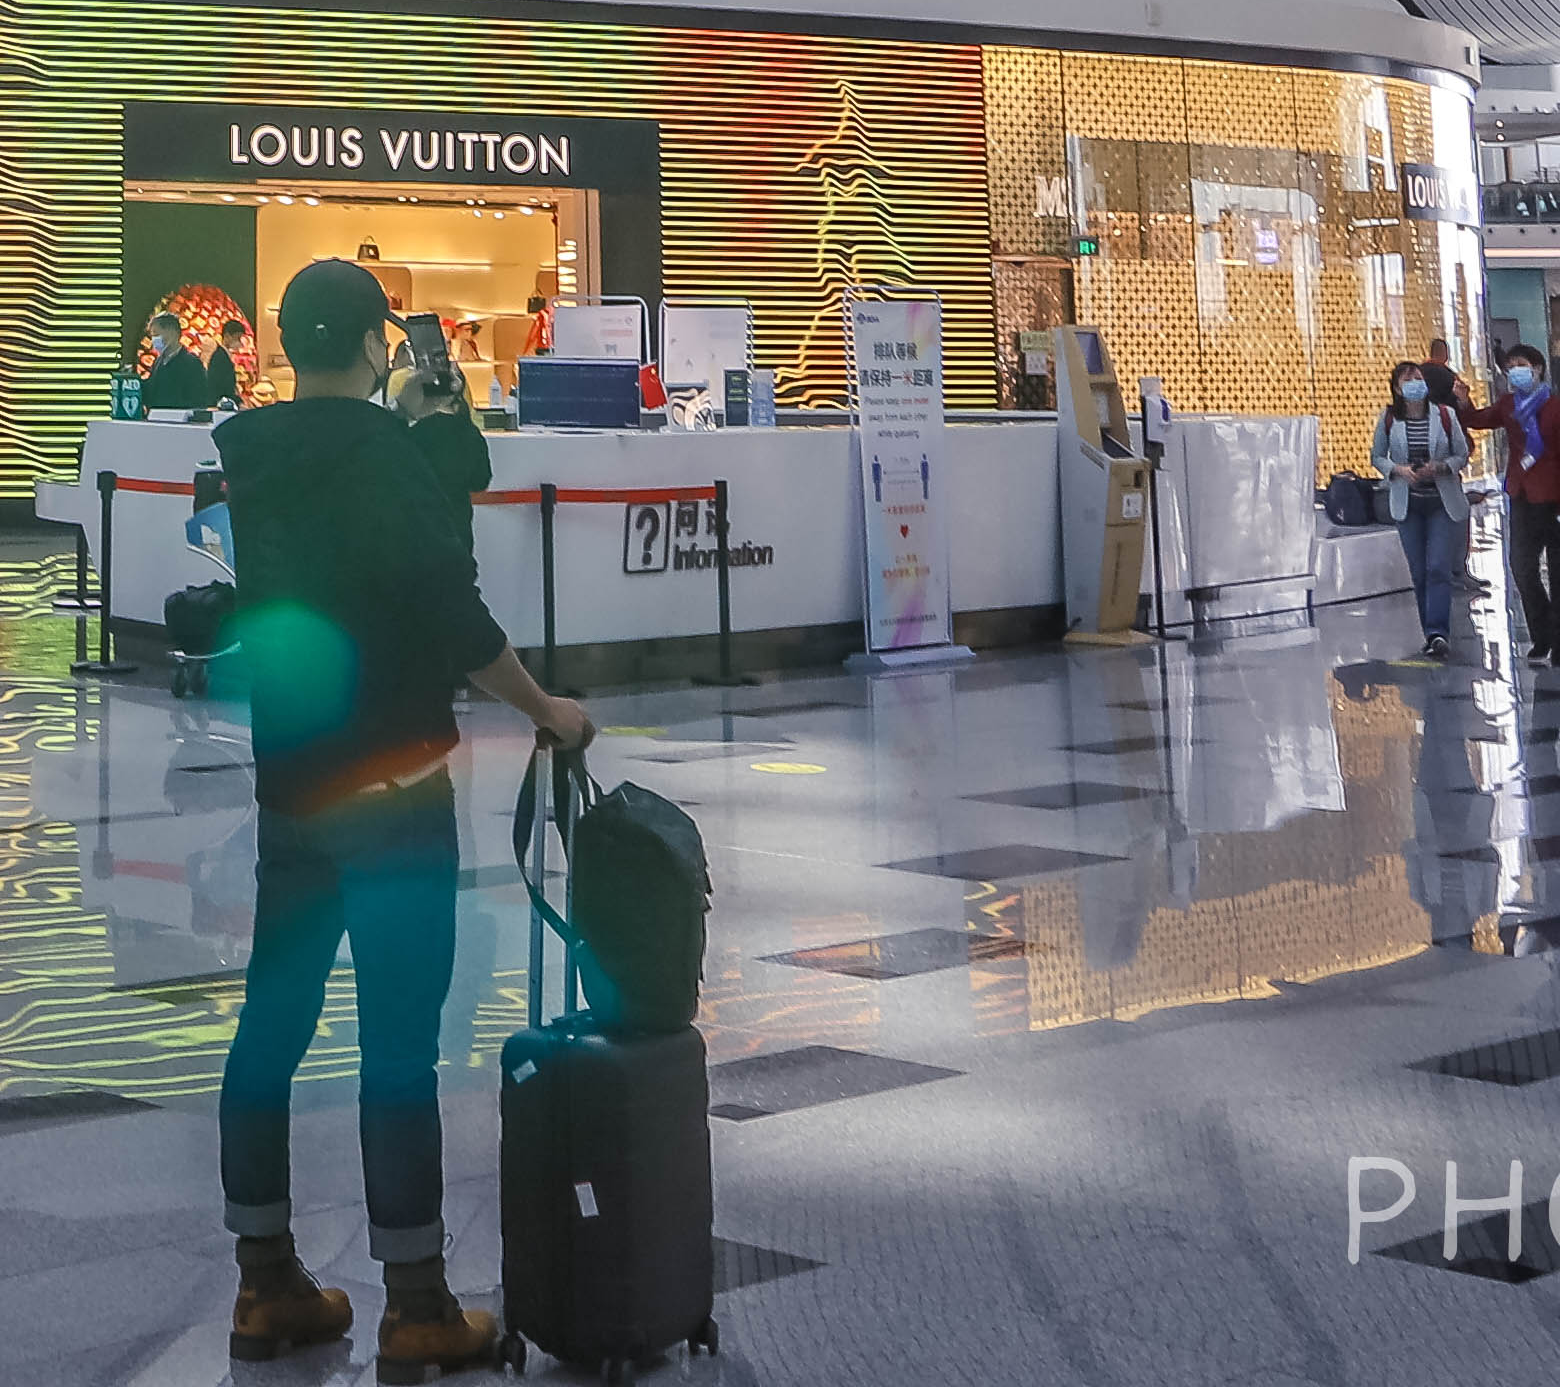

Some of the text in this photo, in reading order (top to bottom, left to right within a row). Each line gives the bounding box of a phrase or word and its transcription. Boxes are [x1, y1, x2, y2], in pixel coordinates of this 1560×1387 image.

[229, 123, 572, 177] LOUIS VUITTON
[1407, 173, 1448, 211] LOUIS
[122, 379, 140, 391] AED
[674, 539, 774, 570] Inforation
